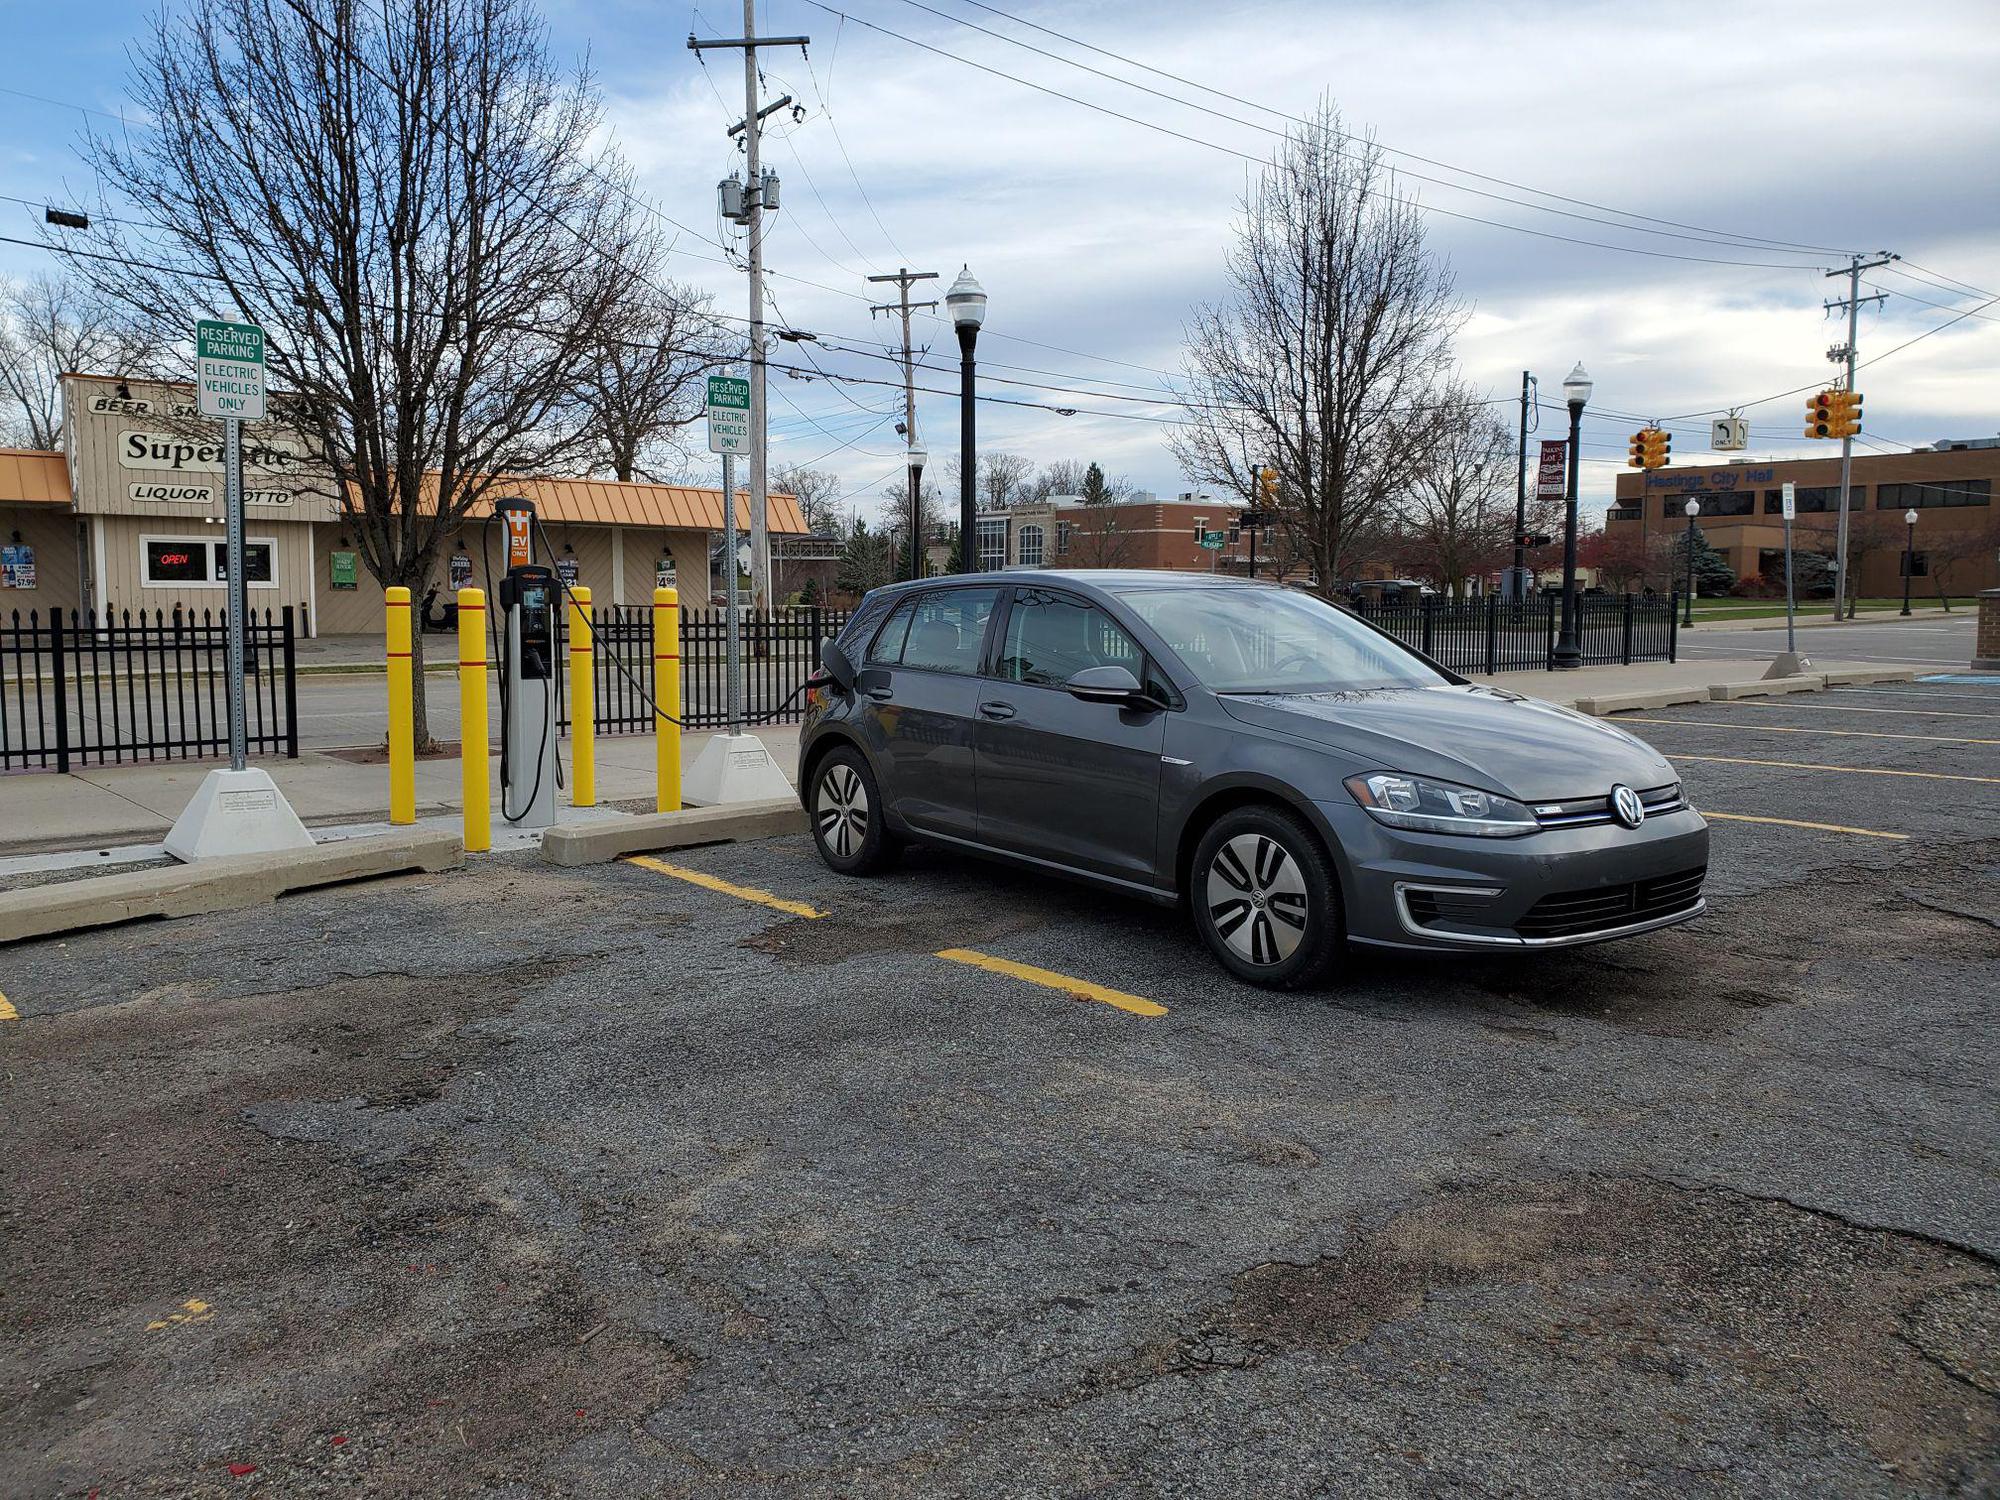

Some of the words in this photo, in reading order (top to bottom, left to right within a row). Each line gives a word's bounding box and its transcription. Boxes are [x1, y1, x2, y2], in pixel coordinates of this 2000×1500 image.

[201, 327, 260, 346] RESERVED
[207, 341, 255, 359] PARKING
[205, 363, 258, 380] ELECTRIC
[205, 380, 259, 396] VEHICLES
[709, 381, 748, 396] RESERVED
[218, 397, 246, 411] ONLY
[713, 393, 745, 406] PARKING
[94, 399, 148, 415] BEER
[712, 410, 746, 423] ELECTRIC
[712, 423, 747, 436] VEHICLES
[721, 437, 739, 449] ONLY
[127, 433, 292, 468] Supertte
[1647, 473, 1704, 488] Hastings
[1711, 471, 1739, 486] City
[1744, 468, 1774, 482] Hall
[135, 486, 210, 500] LIQUOR
[243, 490, 289, 504] OTTO
[511, 536, 527, 546] EV
[160, 554, 188, 565] OPEN
